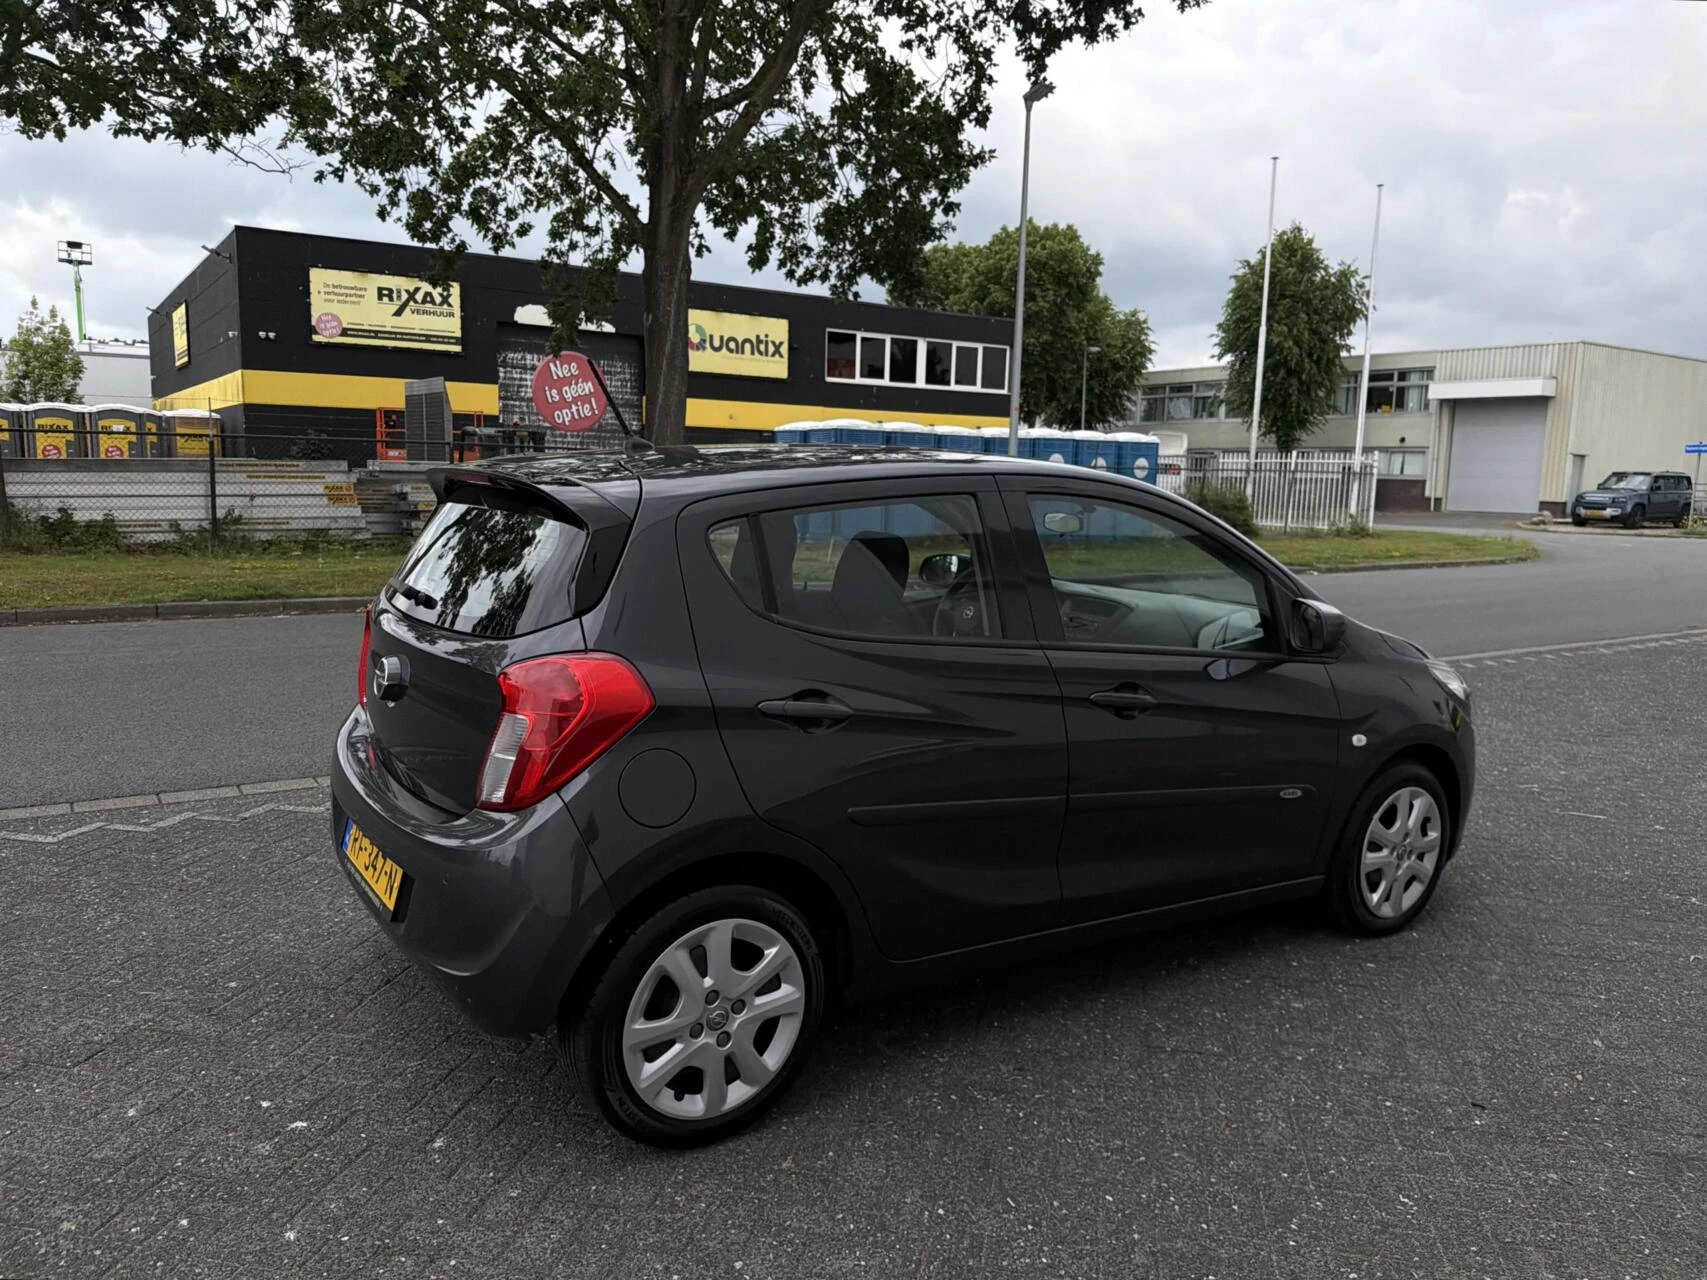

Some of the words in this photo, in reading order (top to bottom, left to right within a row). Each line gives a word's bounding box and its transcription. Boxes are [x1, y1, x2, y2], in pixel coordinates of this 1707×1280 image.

[377, 286, 454, 317] RIXAX
[410, 307, 456, 318] VERHUUR
[549, 360, 579, 380] Nee
[545, 386, 559, 403] is
[562, 378, 595, 402] géén
[554, 397, 599, 425] optie!
